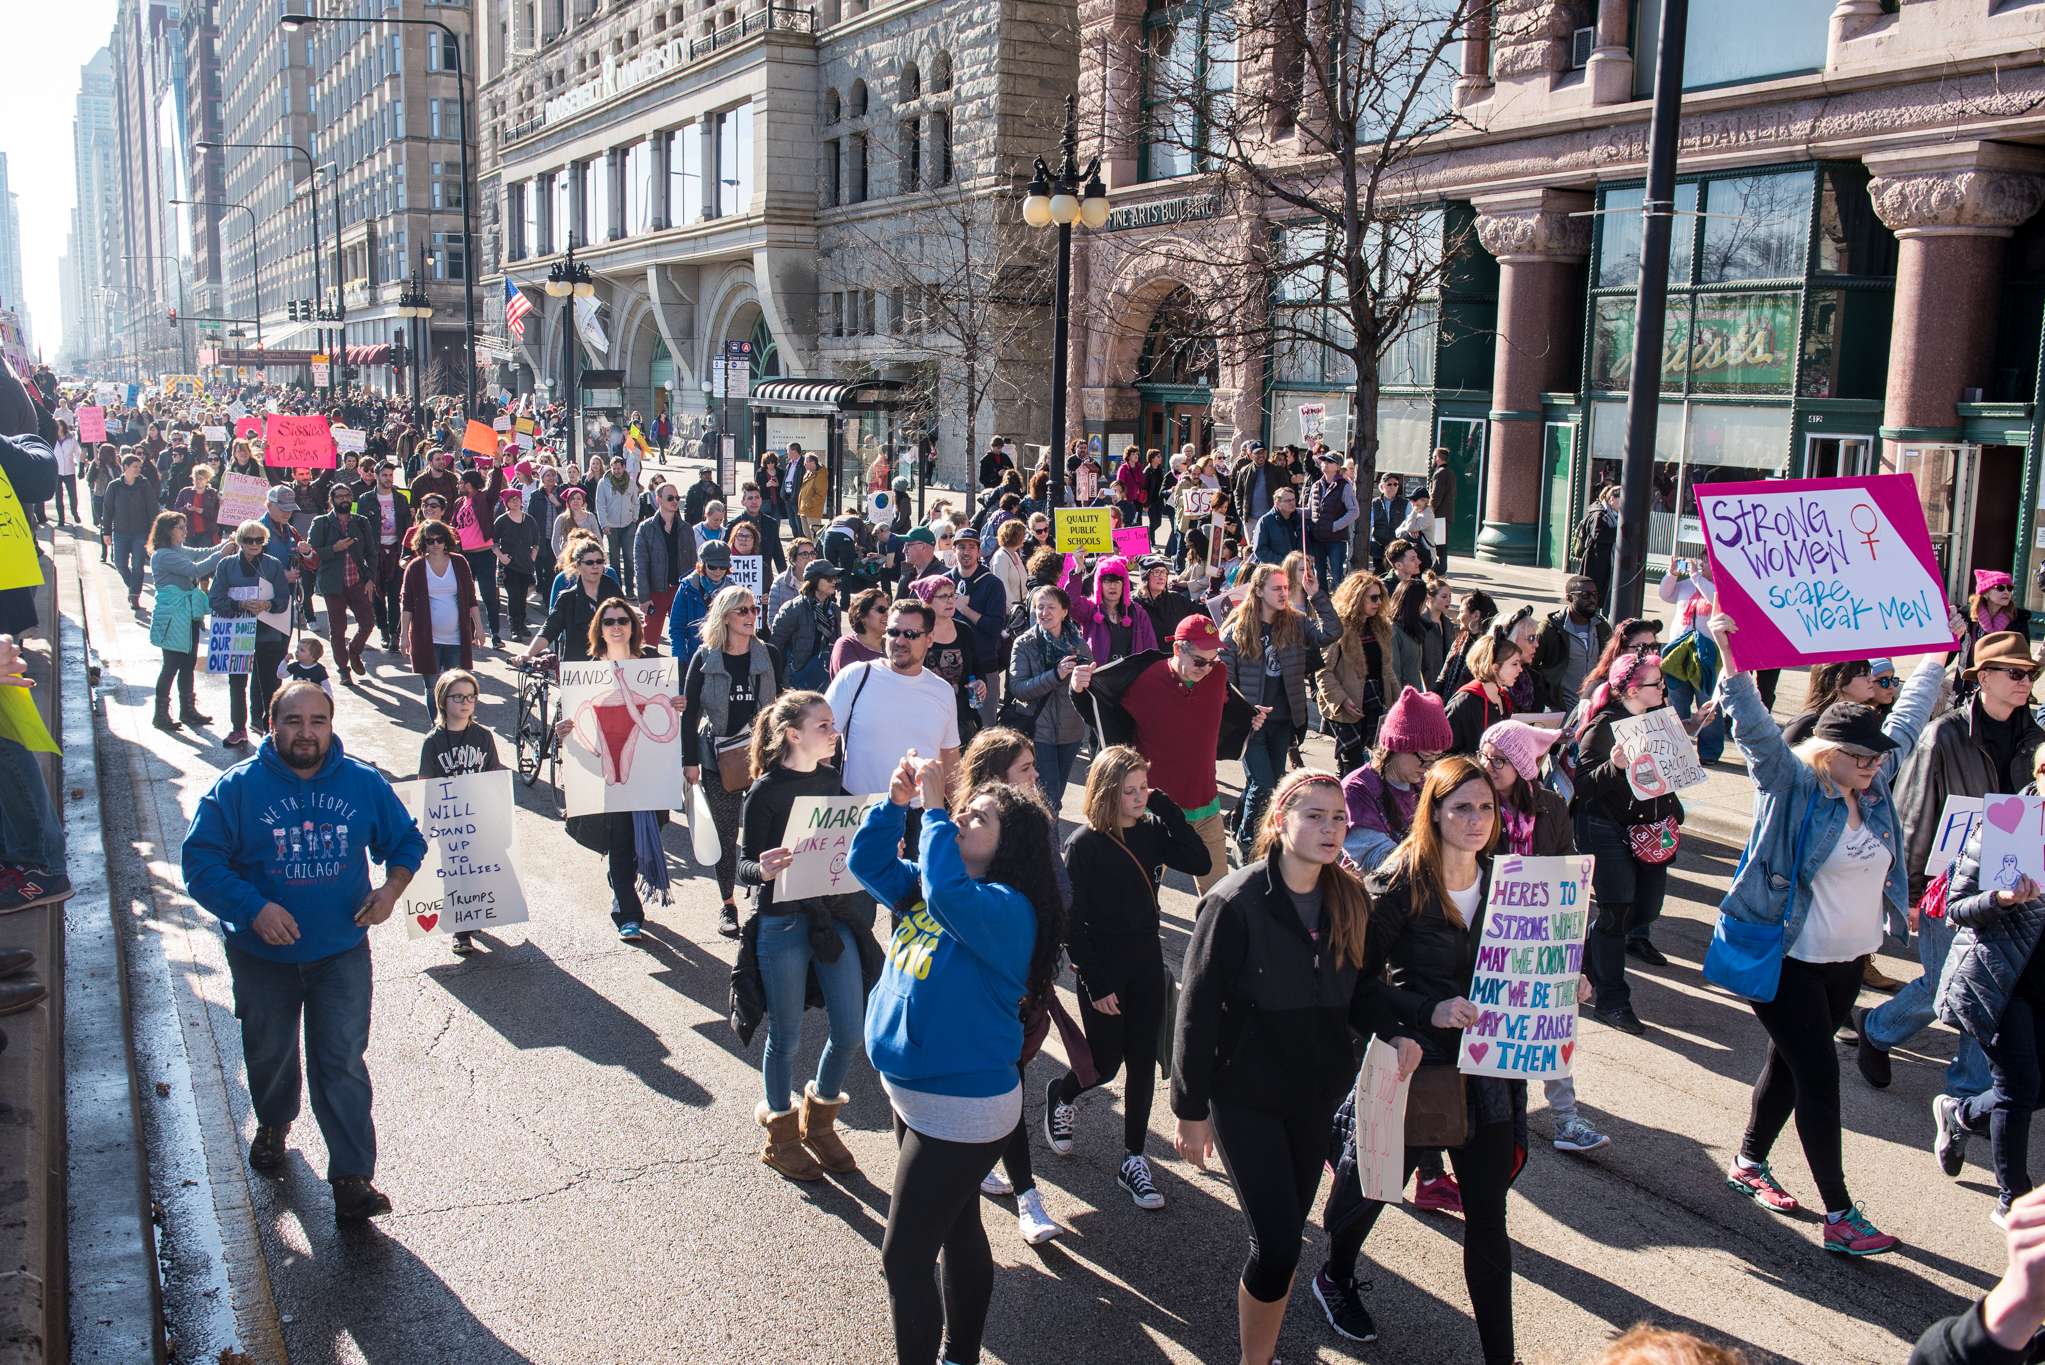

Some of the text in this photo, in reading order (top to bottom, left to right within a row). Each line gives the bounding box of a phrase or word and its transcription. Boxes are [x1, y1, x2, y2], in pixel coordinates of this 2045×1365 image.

[545, 34, 688, 124] ROOSEVELT R UNIVERSITY
[1607, 106, 1795, 160] STEBAKER
[1132, 203, 1158, 226] ARTS
[278, 421, 325, 437] Sissies
[226, 473, 250, 484] THIS
[1066, 515, 1099, 524] QUALITY
[1712, 497, 1834, 548] STRONG
[1070, 526, 1097, 534] PUBLIC
[1068, 538, 1101, 546] SCHOOLS
[733, 559, 758, 570] THE
[732, 572, 758, 582] TIME
[228, 587, 256, 600] TOP
[212, 622, 256, 635] OUR BODIES
[210, 636, 256, 651] OUR PLANET
[209, 654, 254, 672] OUR FUTURE
[562, 663, 674, 688] HANDS OFF!
[1614, 724, 1630, 746] I
[1629, 716, 1664, 738] WILL
[1666, 774, 1683, 790] THE
[439, 782, 458, 801] I
[260, 806, 282, 826] WE
[428, 803, 476, 820] WILL
[808, 806, 873, 830] MARC
[429, 824, 477, 838] STAND
[1636, 831, 1650, 842] Ge
[448, 840, 470, 852] UP
[792, 835, 845, 855] LIKE A
[1653, 848, 1667, 859] Sn
[448, 856, 469, 864] TO
[285, 861, 340, 879] CHICAGO
[436, 863, 501, 878] BULLIES
[1489, 880, 1576, 907] HERE'S TO
[407, 898, 444, 916] LOVE
[455, 907, 498, 924] HATE
[1486, 910, 1586, 941] STRONG WOMEN
[1476, 946, 1511, 972] MAY
[1511, 947, 1534, 974] WE
[1535, 944, 1568, 975] KNOW
[1470, 976, 1509, 1006] MAY
[1507, 980, 1530, 1008] WE
[1530, 981, 1551, 1008] BE
[1466, 1010, 1574, 1041] MAY WE RAISE
[1496, 1041, 1557, 1072] THEM
